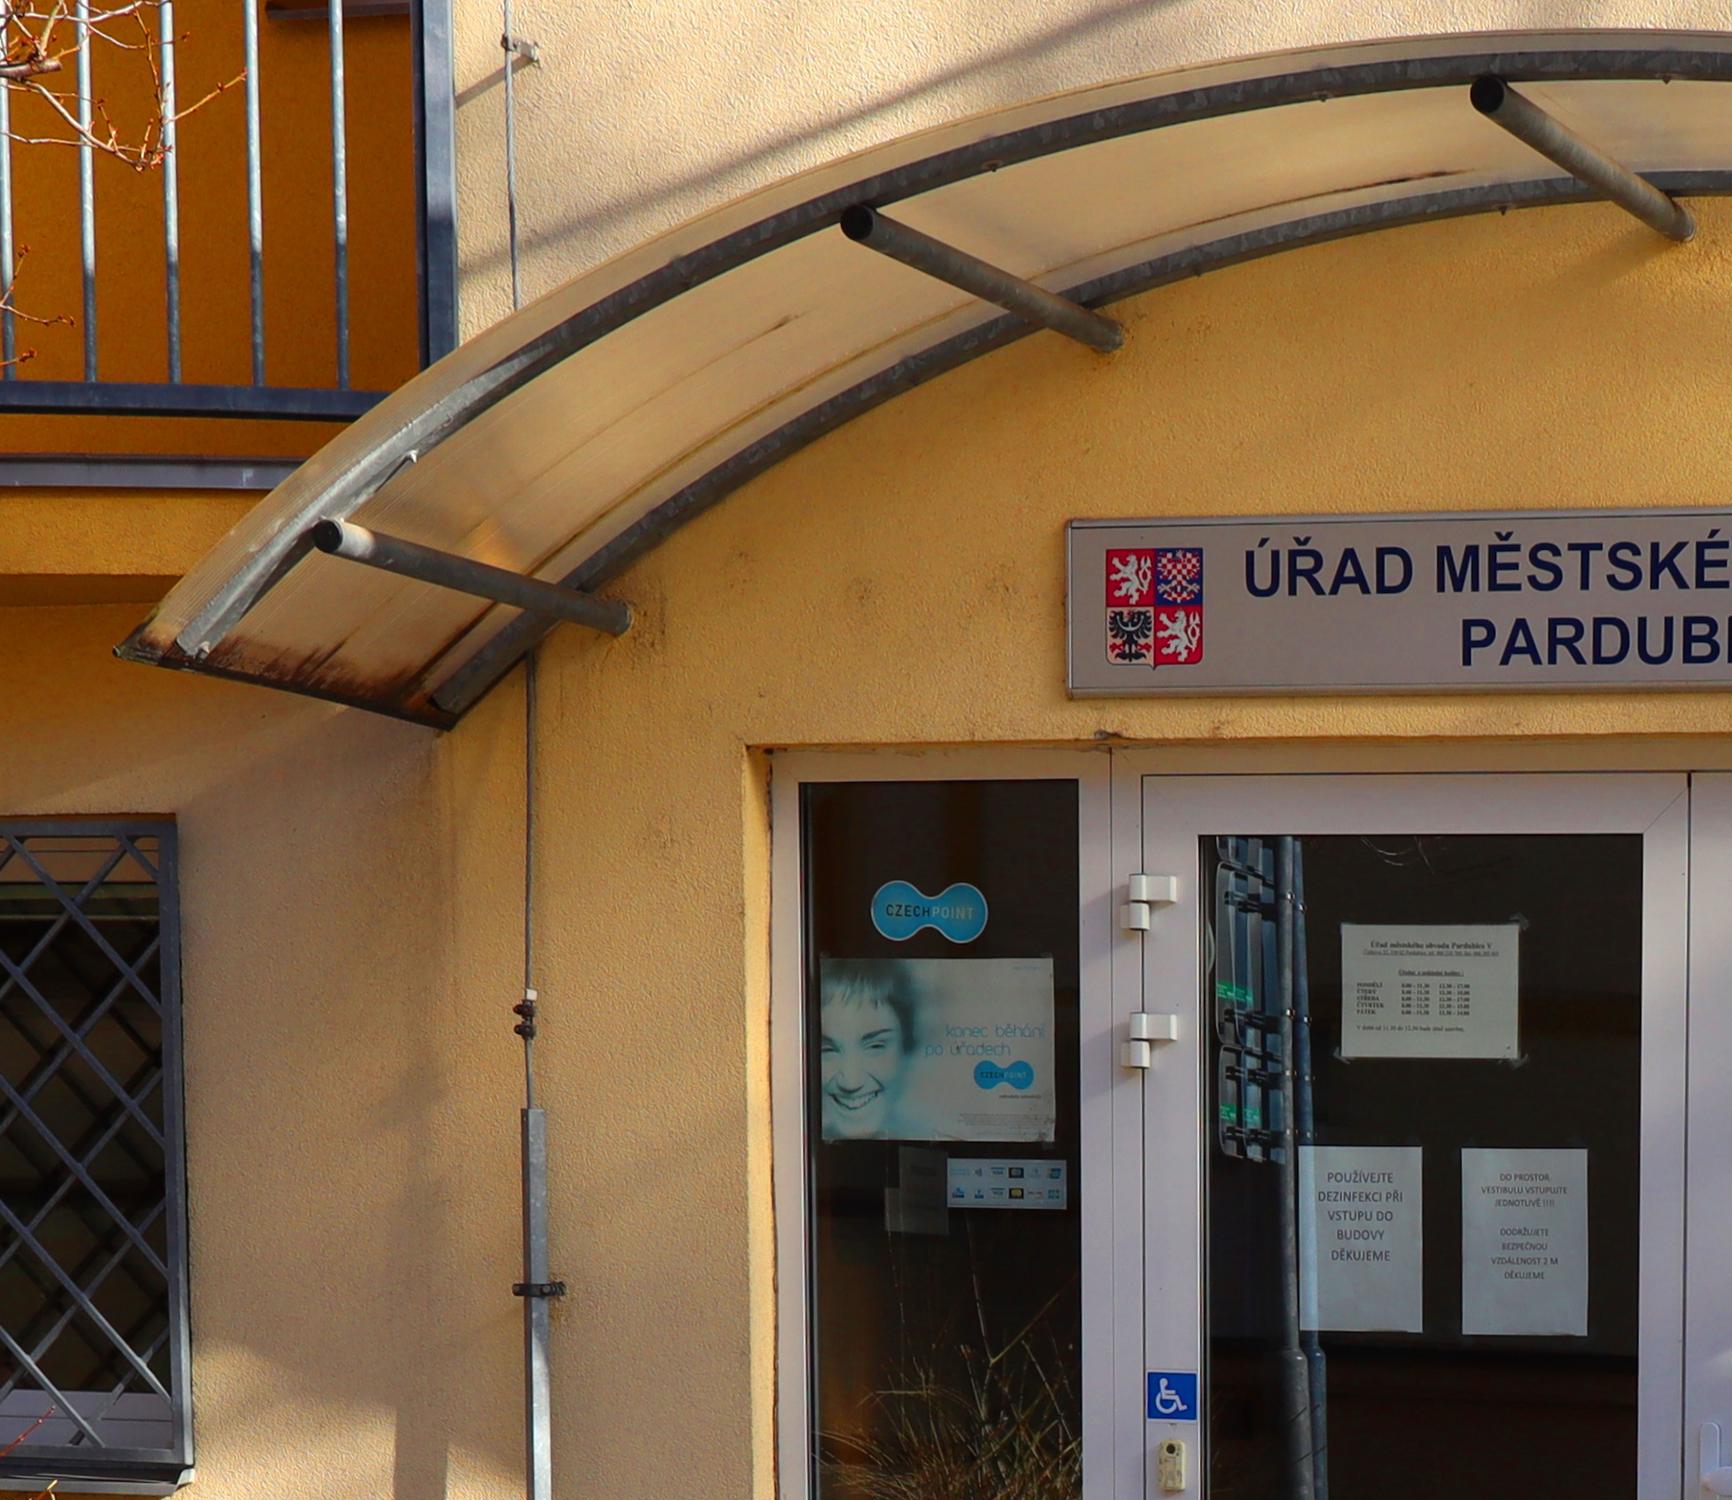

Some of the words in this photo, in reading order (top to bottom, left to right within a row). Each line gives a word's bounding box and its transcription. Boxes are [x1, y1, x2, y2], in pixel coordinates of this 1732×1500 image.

[1243, 533, 1415, 597] ÚŘAD
[1327, 1171, 1393, 1184] POUŽÍVEJTE
[1318, 1190, 1382, 1203] DEZINFEKCI
[1385, 1190, 1403, 1203] PŘI
[1327, 1210, 1373, 1222] VSTUPU
[1376, 1210, 1393, 1222] DO
[1336, 1229, 1384, 1241] BUDOVY
[1331, 1248, 1391, 1262] DĚKUJEME
